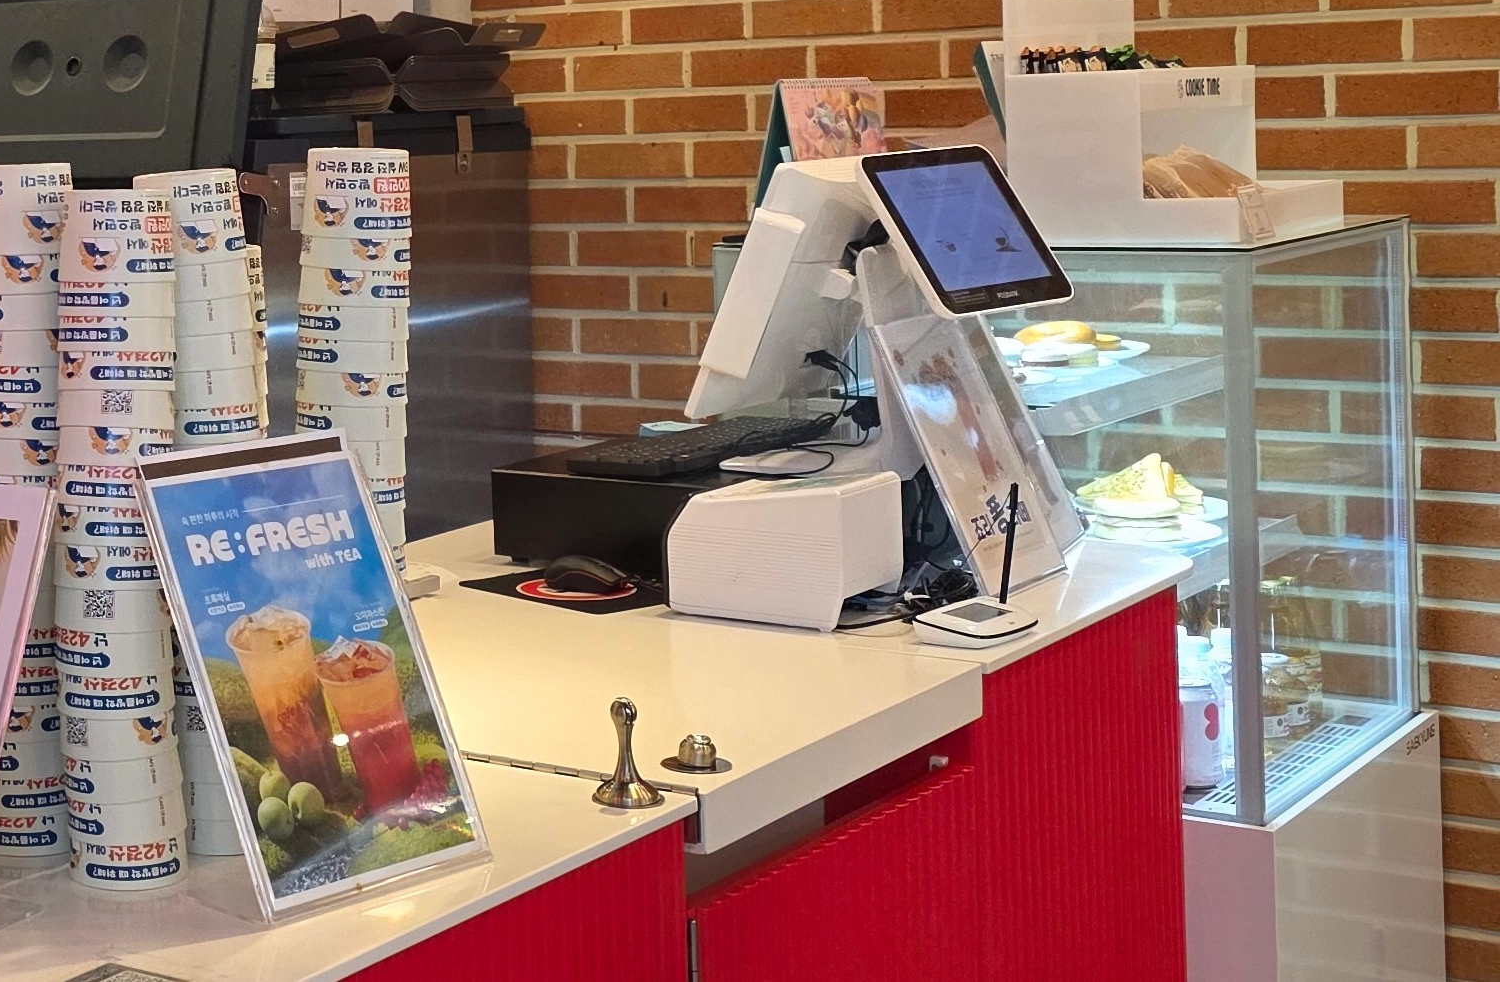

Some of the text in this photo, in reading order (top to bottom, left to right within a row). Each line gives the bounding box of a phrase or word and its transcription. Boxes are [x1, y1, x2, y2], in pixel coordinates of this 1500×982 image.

[316, 160, 396, 174] 실전 경험 쌓는다!
[20, 175, 57, 189] 쌓는다!
[325, 178, 371, 191] 받으면서
[173, 184, 213, 198] 쌓는다!
[79, 200, 118, 214] 쌓는다!
[121, 200, 144, 214] 경험
[191, 199, 231, 214] 받으면서
[93, 218, 141, 231] 받으면서
[186, 509, 355, 566] RE:FRESH
[305, 548, 362, 569] with TEA
[168, 838, 178, 853] 난
